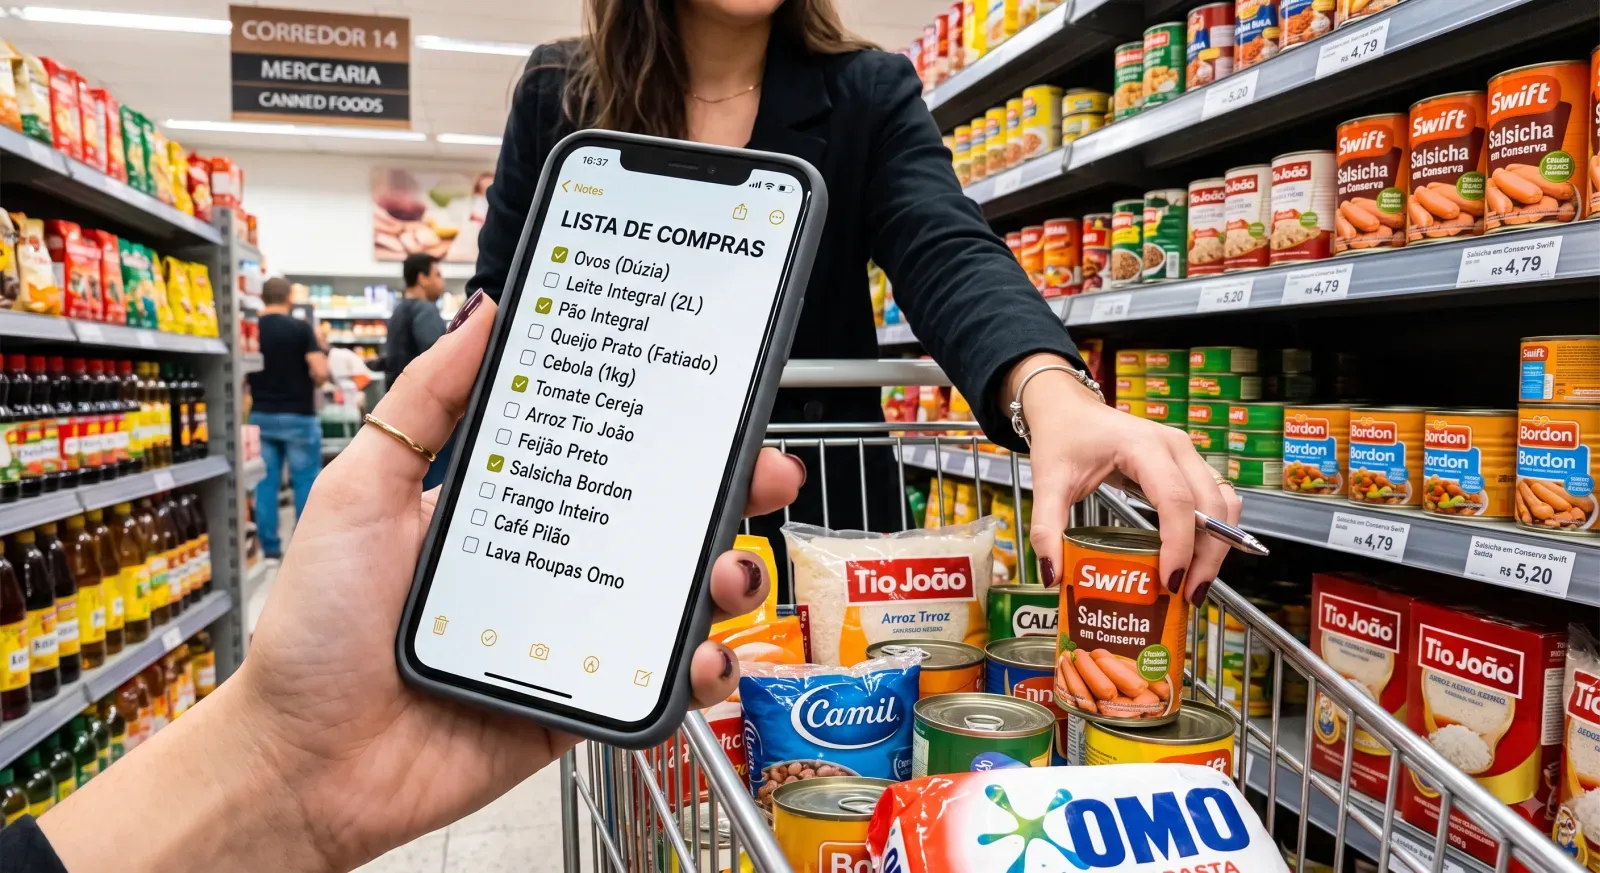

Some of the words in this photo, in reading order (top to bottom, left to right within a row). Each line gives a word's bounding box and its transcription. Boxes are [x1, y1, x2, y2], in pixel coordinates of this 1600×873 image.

[242, 20, 366, 47] CORREDOR
[372, 30, 398, 48] 14
[1350, 39, 1378, 60] 4,79
[261, 60, 381, 86] MERCEARIA
[258, 92, 326, 110] CANNED
[329, 96, 384, 113] FOODS
[1490, 82, 1550, 115] Swift
[1412, 109, 1467, 138] Swift
[1489, 122, 1554, 150] Salsicha
[1338, 130, 1386, 156] Swift
[1501, 142, 1547, 158] Conserva
[582, 156, 608, 167] 16:37
[1411, 144, 1469, 169] Salsicha
[1338, 162, 1388, 185] Salsicha
[1422, 164, 1464, 178] Conserva
[574, 184, 604, 196] Notes
[1347, 181, 1384, 193] Conserva
[561, 210, 618, 236] LISTA
[623, 219, 654, 241] DE
[656, 225, 766, 258] COMPRAS
[1504, 244, 1535, 253] Conserva
[1536, 241, 1555, 250] Swift
[574, 251, 611, 270] Ovos
[616, 256, 670, 282] (Dúzia)
[1491, 268, 1502, 276] R$
[1505, 256, 1542, 276] 4,79
[566, 276, 603, 295] Leite
[607, 283, 666, 307] Integral
[670, 292, 703, 316] (2L)
[1314, 280, 1339, 295] 4,79
[558, 302, 586, 320] Pão
[591, 307, 650, 332] Integral
[550, 327, 597, 352] Queijo
[602, 337, 642, 358] Prato
[648, 344, 718, 375] (Fatiado)
[1523, 348, 1545, 358] Swift
[543, 354, 593, 377] Cebola
[598, 363, 636, 388] (1kg)
[536, 380, 590, 404] Tomate
[595, 392, 644, 417] Cereja
[525, 407, 566, 428] Arroz
[572, 415, 593, 434] Tio
[597, 422, 634, 442] João
[1285, 421, 1325, 436] Bordon
[1351, 425, 1392, 440] Bordon
[1425, 428, 1466, 445] Bordon
[1520, 426, 1572, 442] Bordon
[518, 433, 563, 456] Feijão
[567, 443, 609, 466] Preto
[1284, 441, 1327, 456] Bordon
[1350, 446, 1395, 462] Bordon
[1424, 452, 1468, 469] Bordon
[1519, 450, 1575, 469] Bordon
[510, 460, 572, 488] Salsicha
[576, 474, 632, 500] Bordon
[501, 487, 554, 514] Frango
[559, 501, 609, 525] Inteiro
[494, 514, 528, 535] Café
[533, 523, 570, 546] Pilão
[1366, 521, 1390, 530] Conserva
[1354, 536, 1362, 544] R$
[1364, 534, 1393, 551] 4,79
[1475, 541, 1501, 551] Salsicha
[1514, 548, 1546, 559] Conserva
[1548, 554, 1567, 563] Swift
[486, 542, 521, 564] Lava
[525, 551, 582, 579] Roupas
[587, 566, 625, 589] Omo
[1500, 566, 1511, 576] R$
[1515, 563, 1552, 585] 5,20
[854, 569, 896, 594] Tio
[900, 567, 966, 592] João
[1079, 564, 1151, 595] Swift
[882, 613, 916, 624] Arroz
[919, 611, 950, 622] Trroz
[1078, 605, 1150, 633] Salsicha
[1324, 603, 1347, 628] Tio
[1348, 611, 1392, 641] João
[1080, 629, 1094, 640] em
[1096, 631, 1146, 646] Conserva
[1425, 636, 1454, 666] Tio
[1455, 648, 1514, 684] João
[806, 697, 897, 728] Camil
[1064, 787, 1250, 868] OMO
